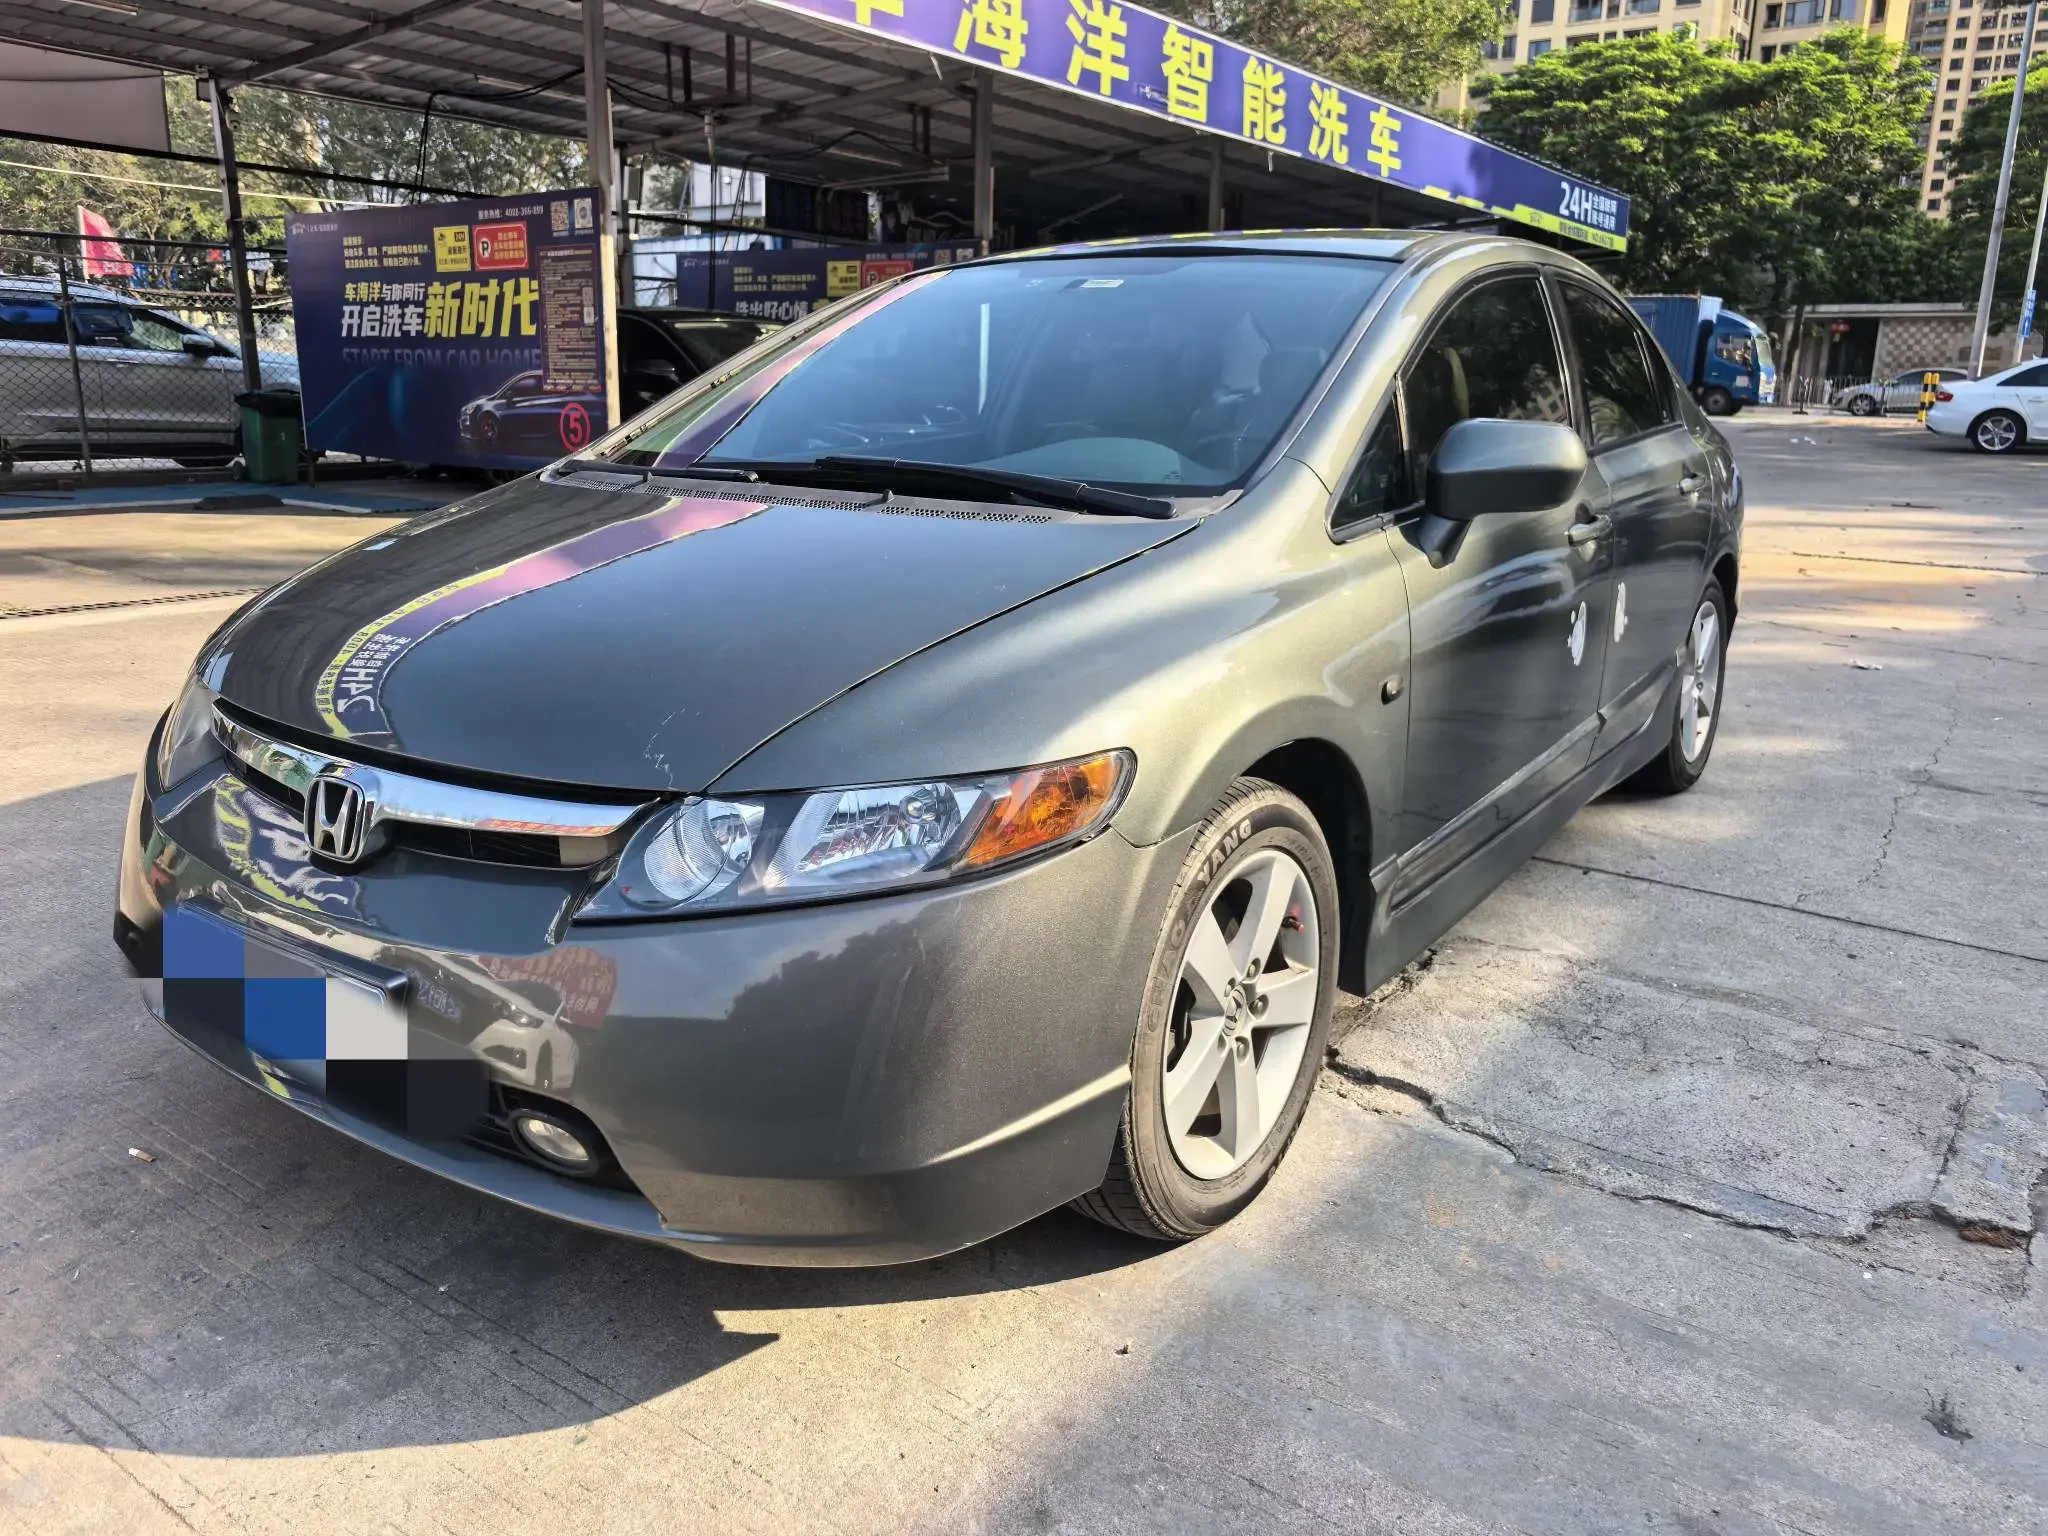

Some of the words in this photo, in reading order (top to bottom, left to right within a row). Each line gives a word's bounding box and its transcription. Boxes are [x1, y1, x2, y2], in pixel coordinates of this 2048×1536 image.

[1559, 181, 1593, 224] 24H
[341, 304, 425, 338] 开启洗车
[423, 277, 540, 338] 新时代
